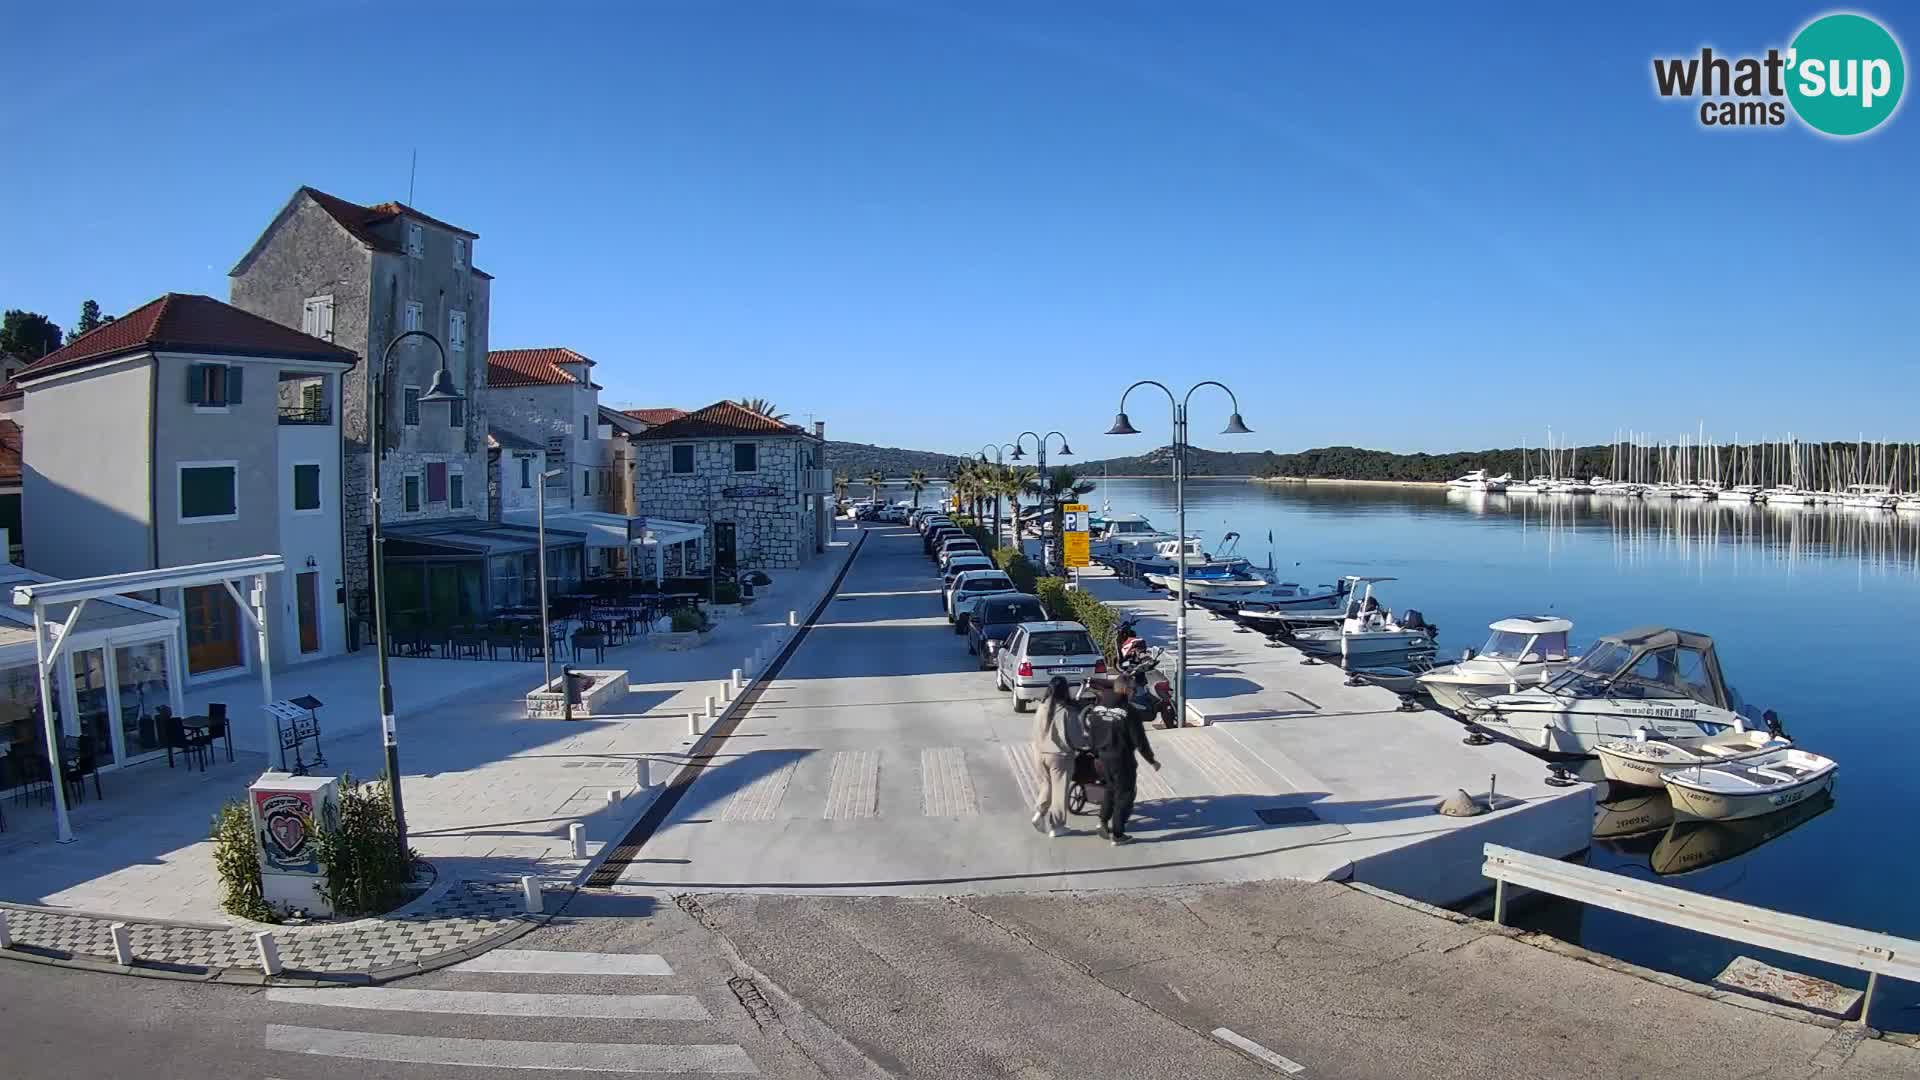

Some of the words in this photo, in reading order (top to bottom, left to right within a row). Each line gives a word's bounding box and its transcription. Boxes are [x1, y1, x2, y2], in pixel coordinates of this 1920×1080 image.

[1066, 514, 1076, 530] P
[1655, 708, 1673, 717] RENT
[1674, 709, 1679, 717] A
[1680, 708, 1697, 719] BOAT
